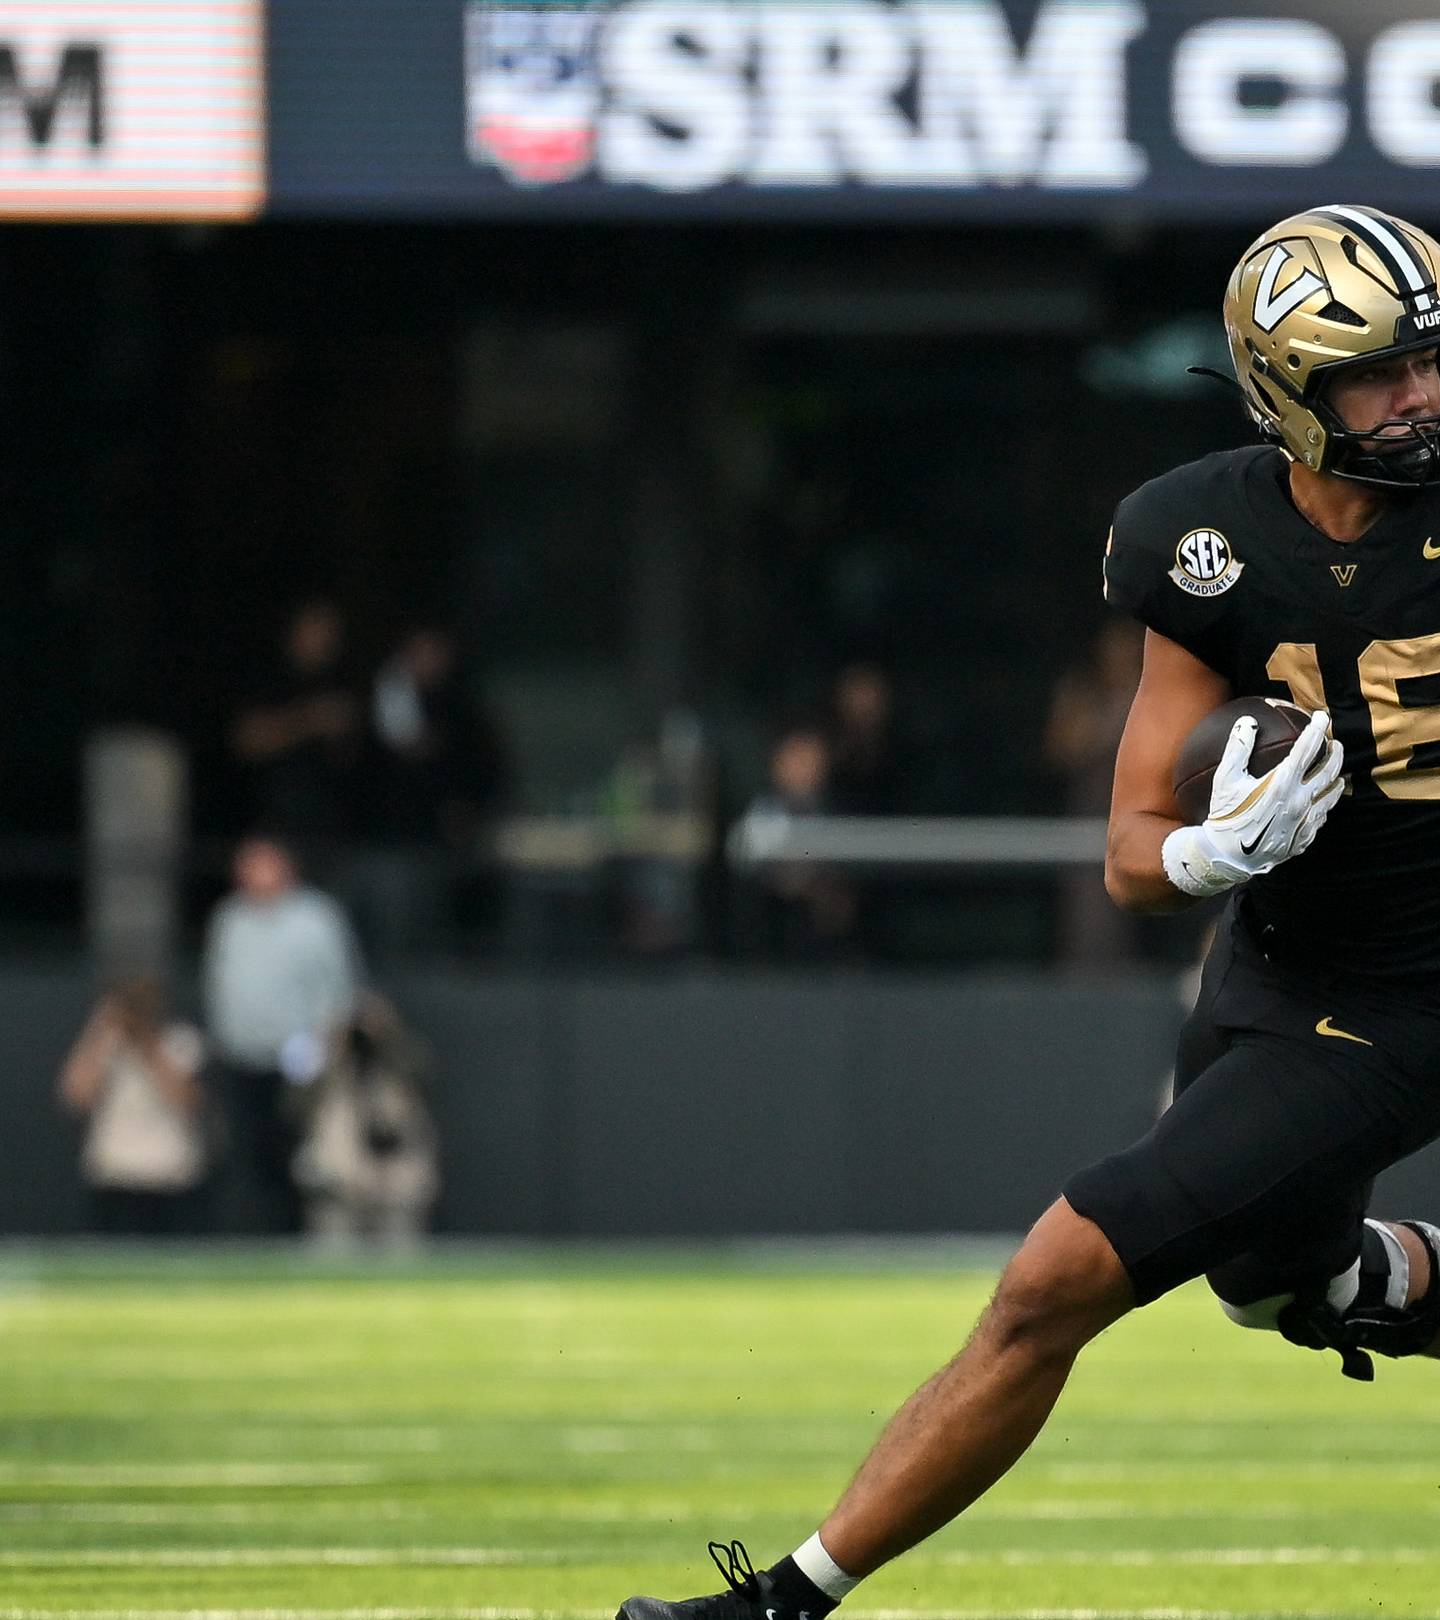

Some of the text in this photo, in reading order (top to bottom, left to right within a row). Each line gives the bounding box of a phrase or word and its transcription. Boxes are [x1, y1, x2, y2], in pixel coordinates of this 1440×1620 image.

[603, 0, 1148, 191] SRM
[1253, 241, 1331, 335] V
[1180, 531, 1227, 579] SEC
[1330, 565, 1358, 586] V
[1179, 573, 1236, 596] GRADUATE
